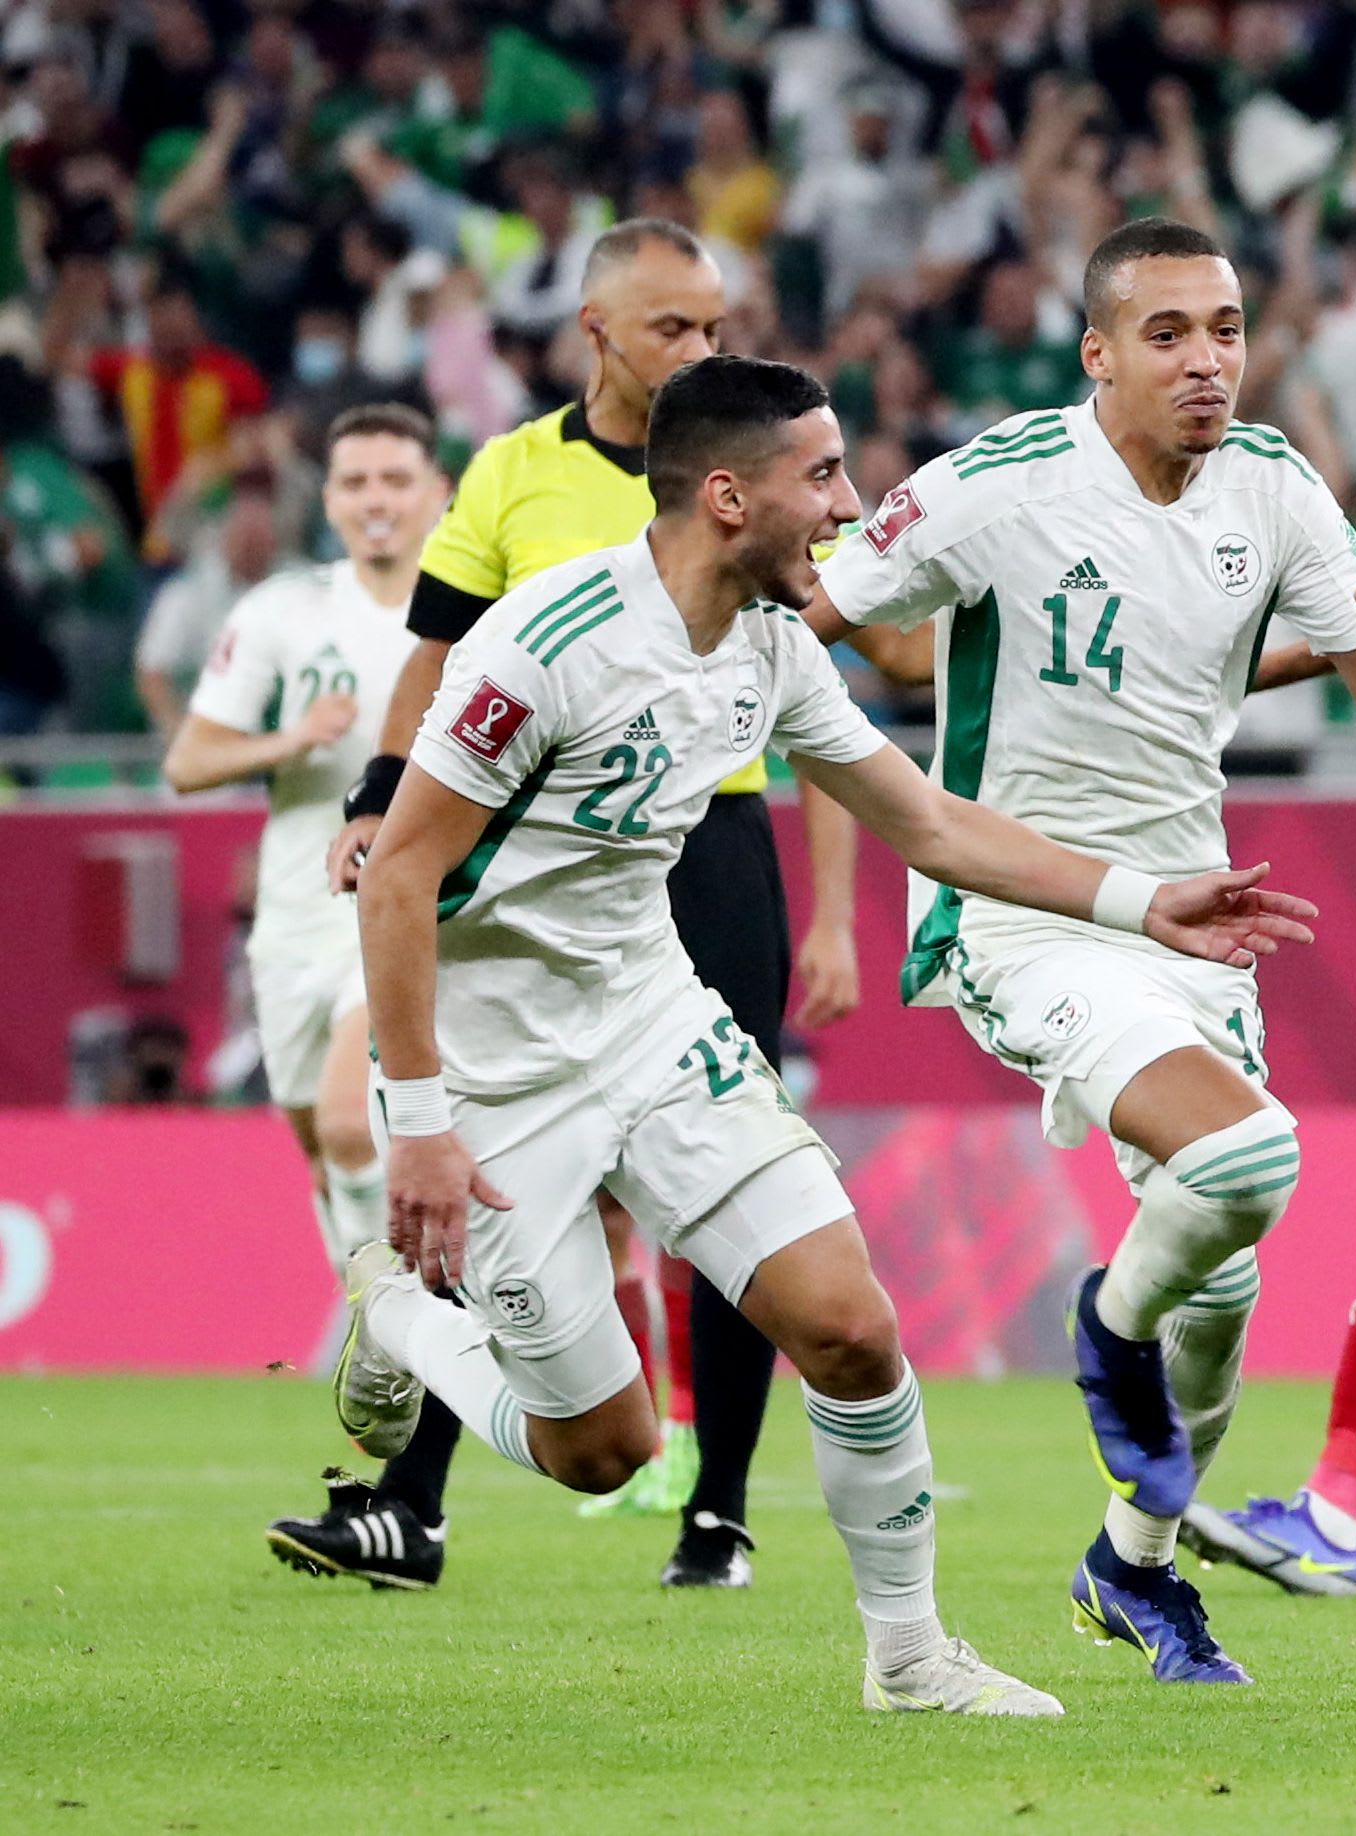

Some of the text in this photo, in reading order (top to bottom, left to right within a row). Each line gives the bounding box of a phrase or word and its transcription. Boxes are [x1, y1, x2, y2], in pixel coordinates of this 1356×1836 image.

[1060, 578, 1108, 590] adidas
[1039, 593, 1124, 693] 14
[623, 730, 661, 741] adidas
[573, 743, 673, 835] 22
